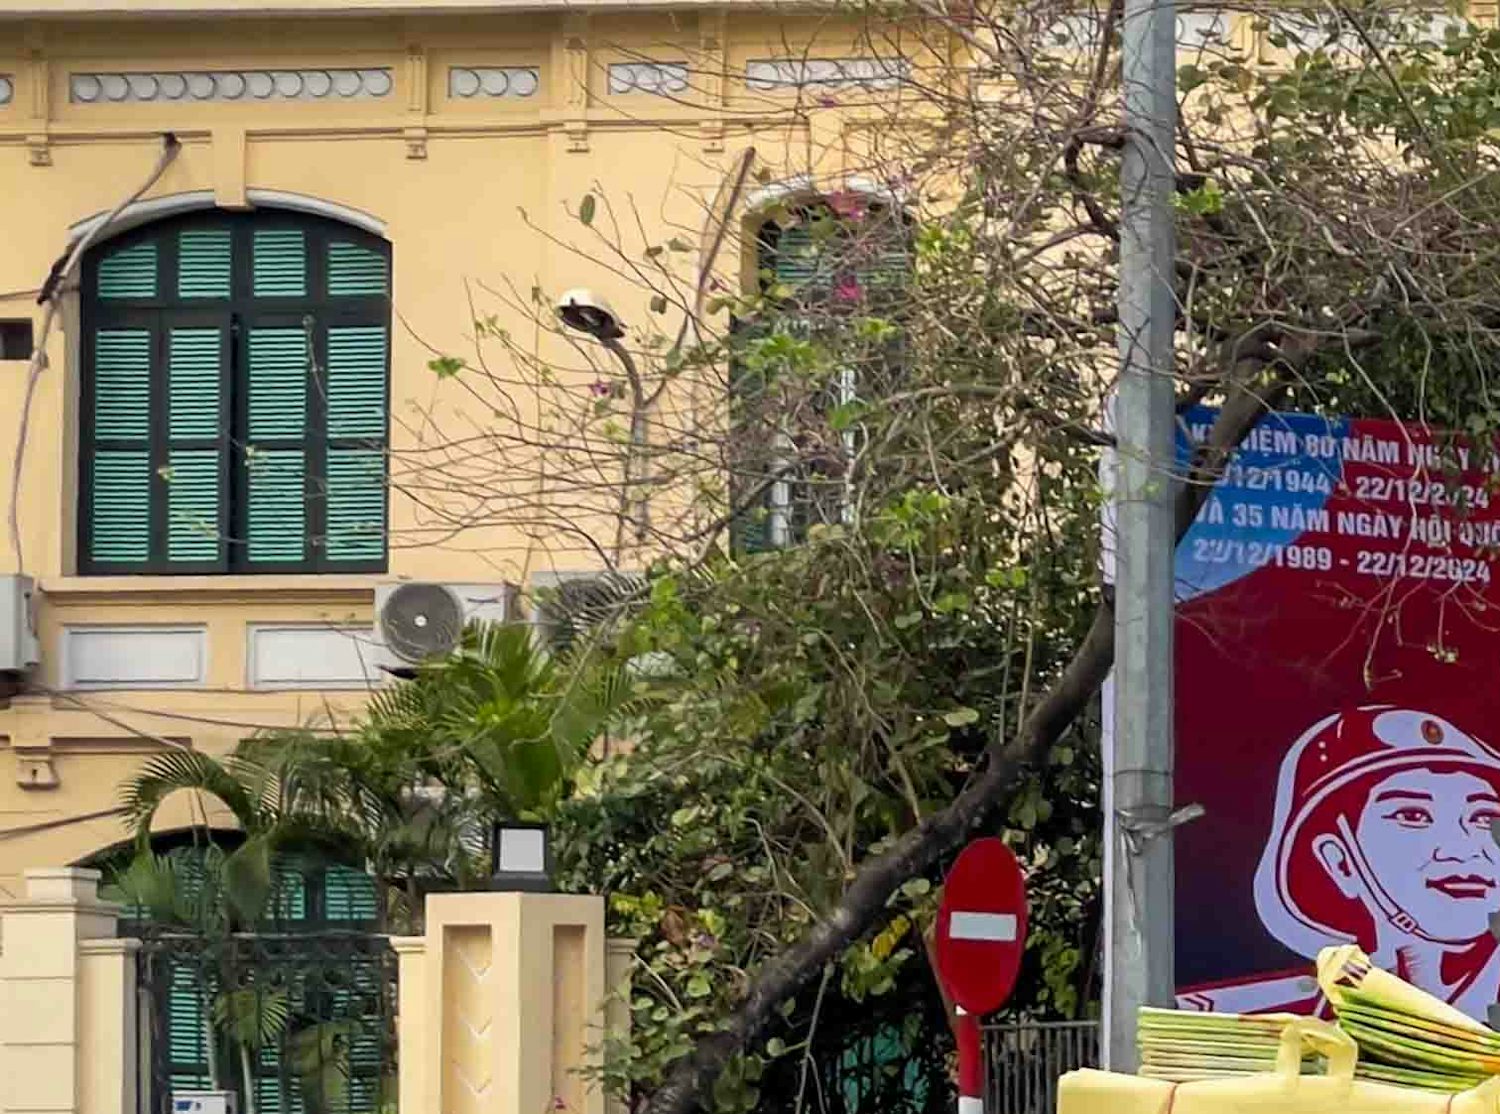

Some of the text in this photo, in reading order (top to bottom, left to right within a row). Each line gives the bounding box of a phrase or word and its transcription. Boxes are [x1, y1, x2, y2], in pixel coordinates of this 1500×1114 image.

[1306, 434, 1337, 458] 80
[1343, 435, 1400, 464] NĂM
[1408, 443, 1470, 471] NGY
[1216, 463, 1332, 495] /12/1944
[1232, 503, 1264, 528] 35
[1271, 504, 1330, 532] NĂM
[1337, 510, 1403, 539] NGÀY
[1356, 550, 1492, 584] 22/12/2024
